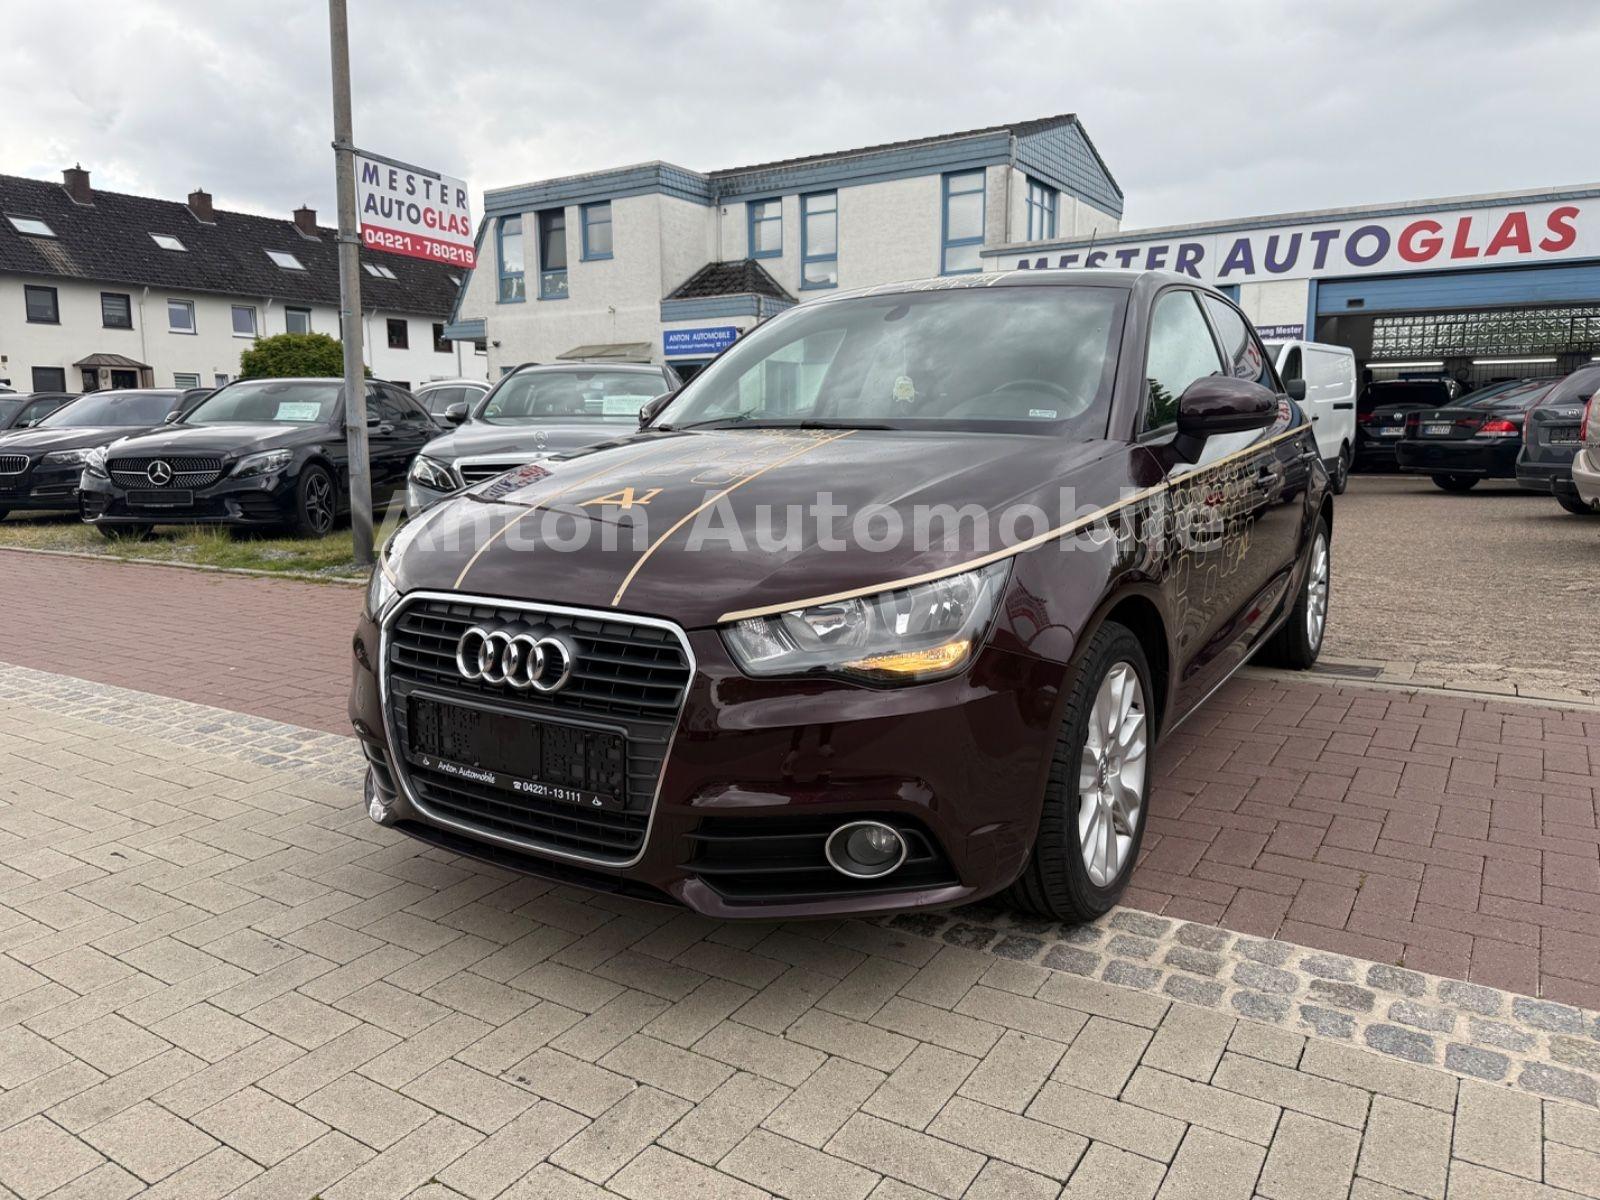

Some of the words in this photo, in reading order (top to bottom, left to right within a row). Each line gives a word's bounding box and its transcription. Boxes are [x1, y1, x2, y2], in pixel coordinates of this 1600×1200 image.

[362, 162, 466, 209] MESTER
[364, 193, 470, 237] AUTOGLAS
[423, 241, 474, 263] 780219
[1217, 206, 1581, 278] AUTOGLAS
[669, 334, 690, 342] ANTON
[692, 331, 731, 340] AUTOMOBILE
[1276, 326, 1302, 335] Mester
[438, 761, 458, 774] Anton
[458, 767, 496, 784] Automobile
